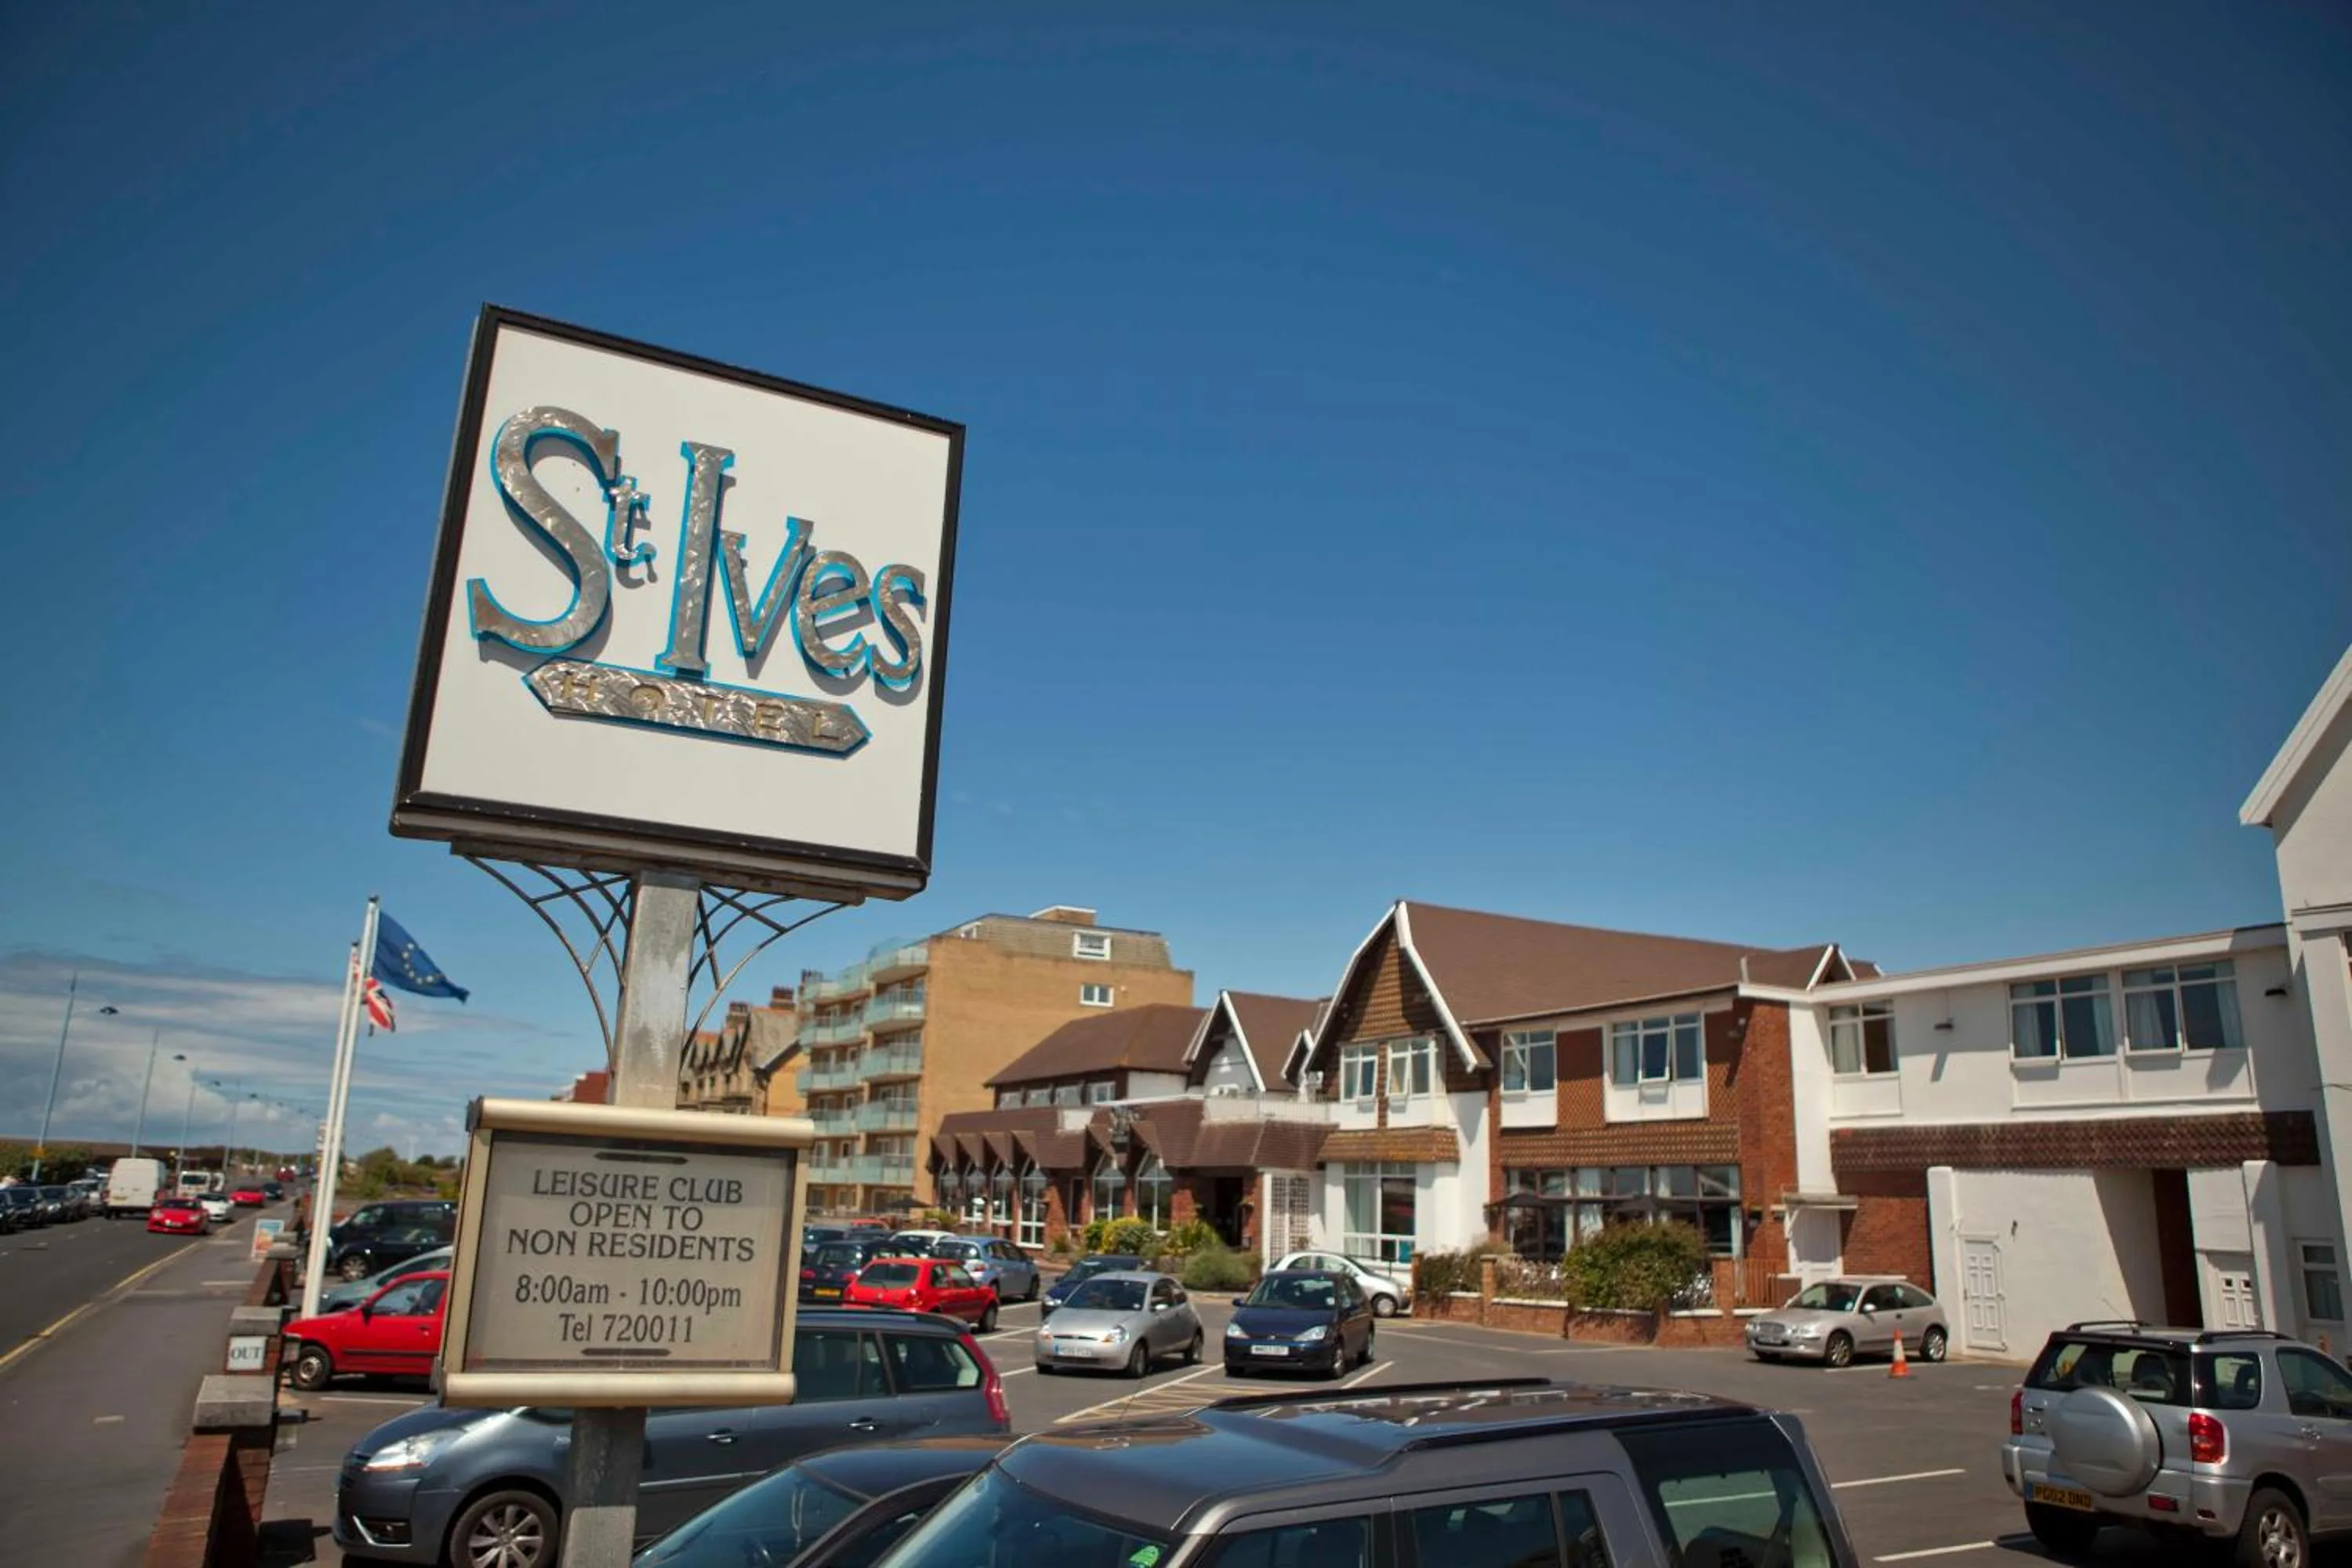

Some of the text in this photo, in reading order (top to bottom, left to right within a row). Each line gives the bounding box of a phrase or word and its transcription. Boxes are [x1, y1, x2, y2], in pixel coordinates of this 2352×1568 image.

[466, 405, 925, 692] St Ives
[560, 670, 843, 742] HOTEL
[532, 1169, 743, 1204] LEISURE CLUB
[569, 1201, 704, 1232] OPEN TO
[506, 1229, 755, 1262] NON RESIDENTS
[514, 1274, 609, 1304] 8:00am
[639, 1278, 742, 1316] 10:00pm
[559, 1313, 693, 1343] Tel 720011
[230, 1346, 263, 1360] OUT
